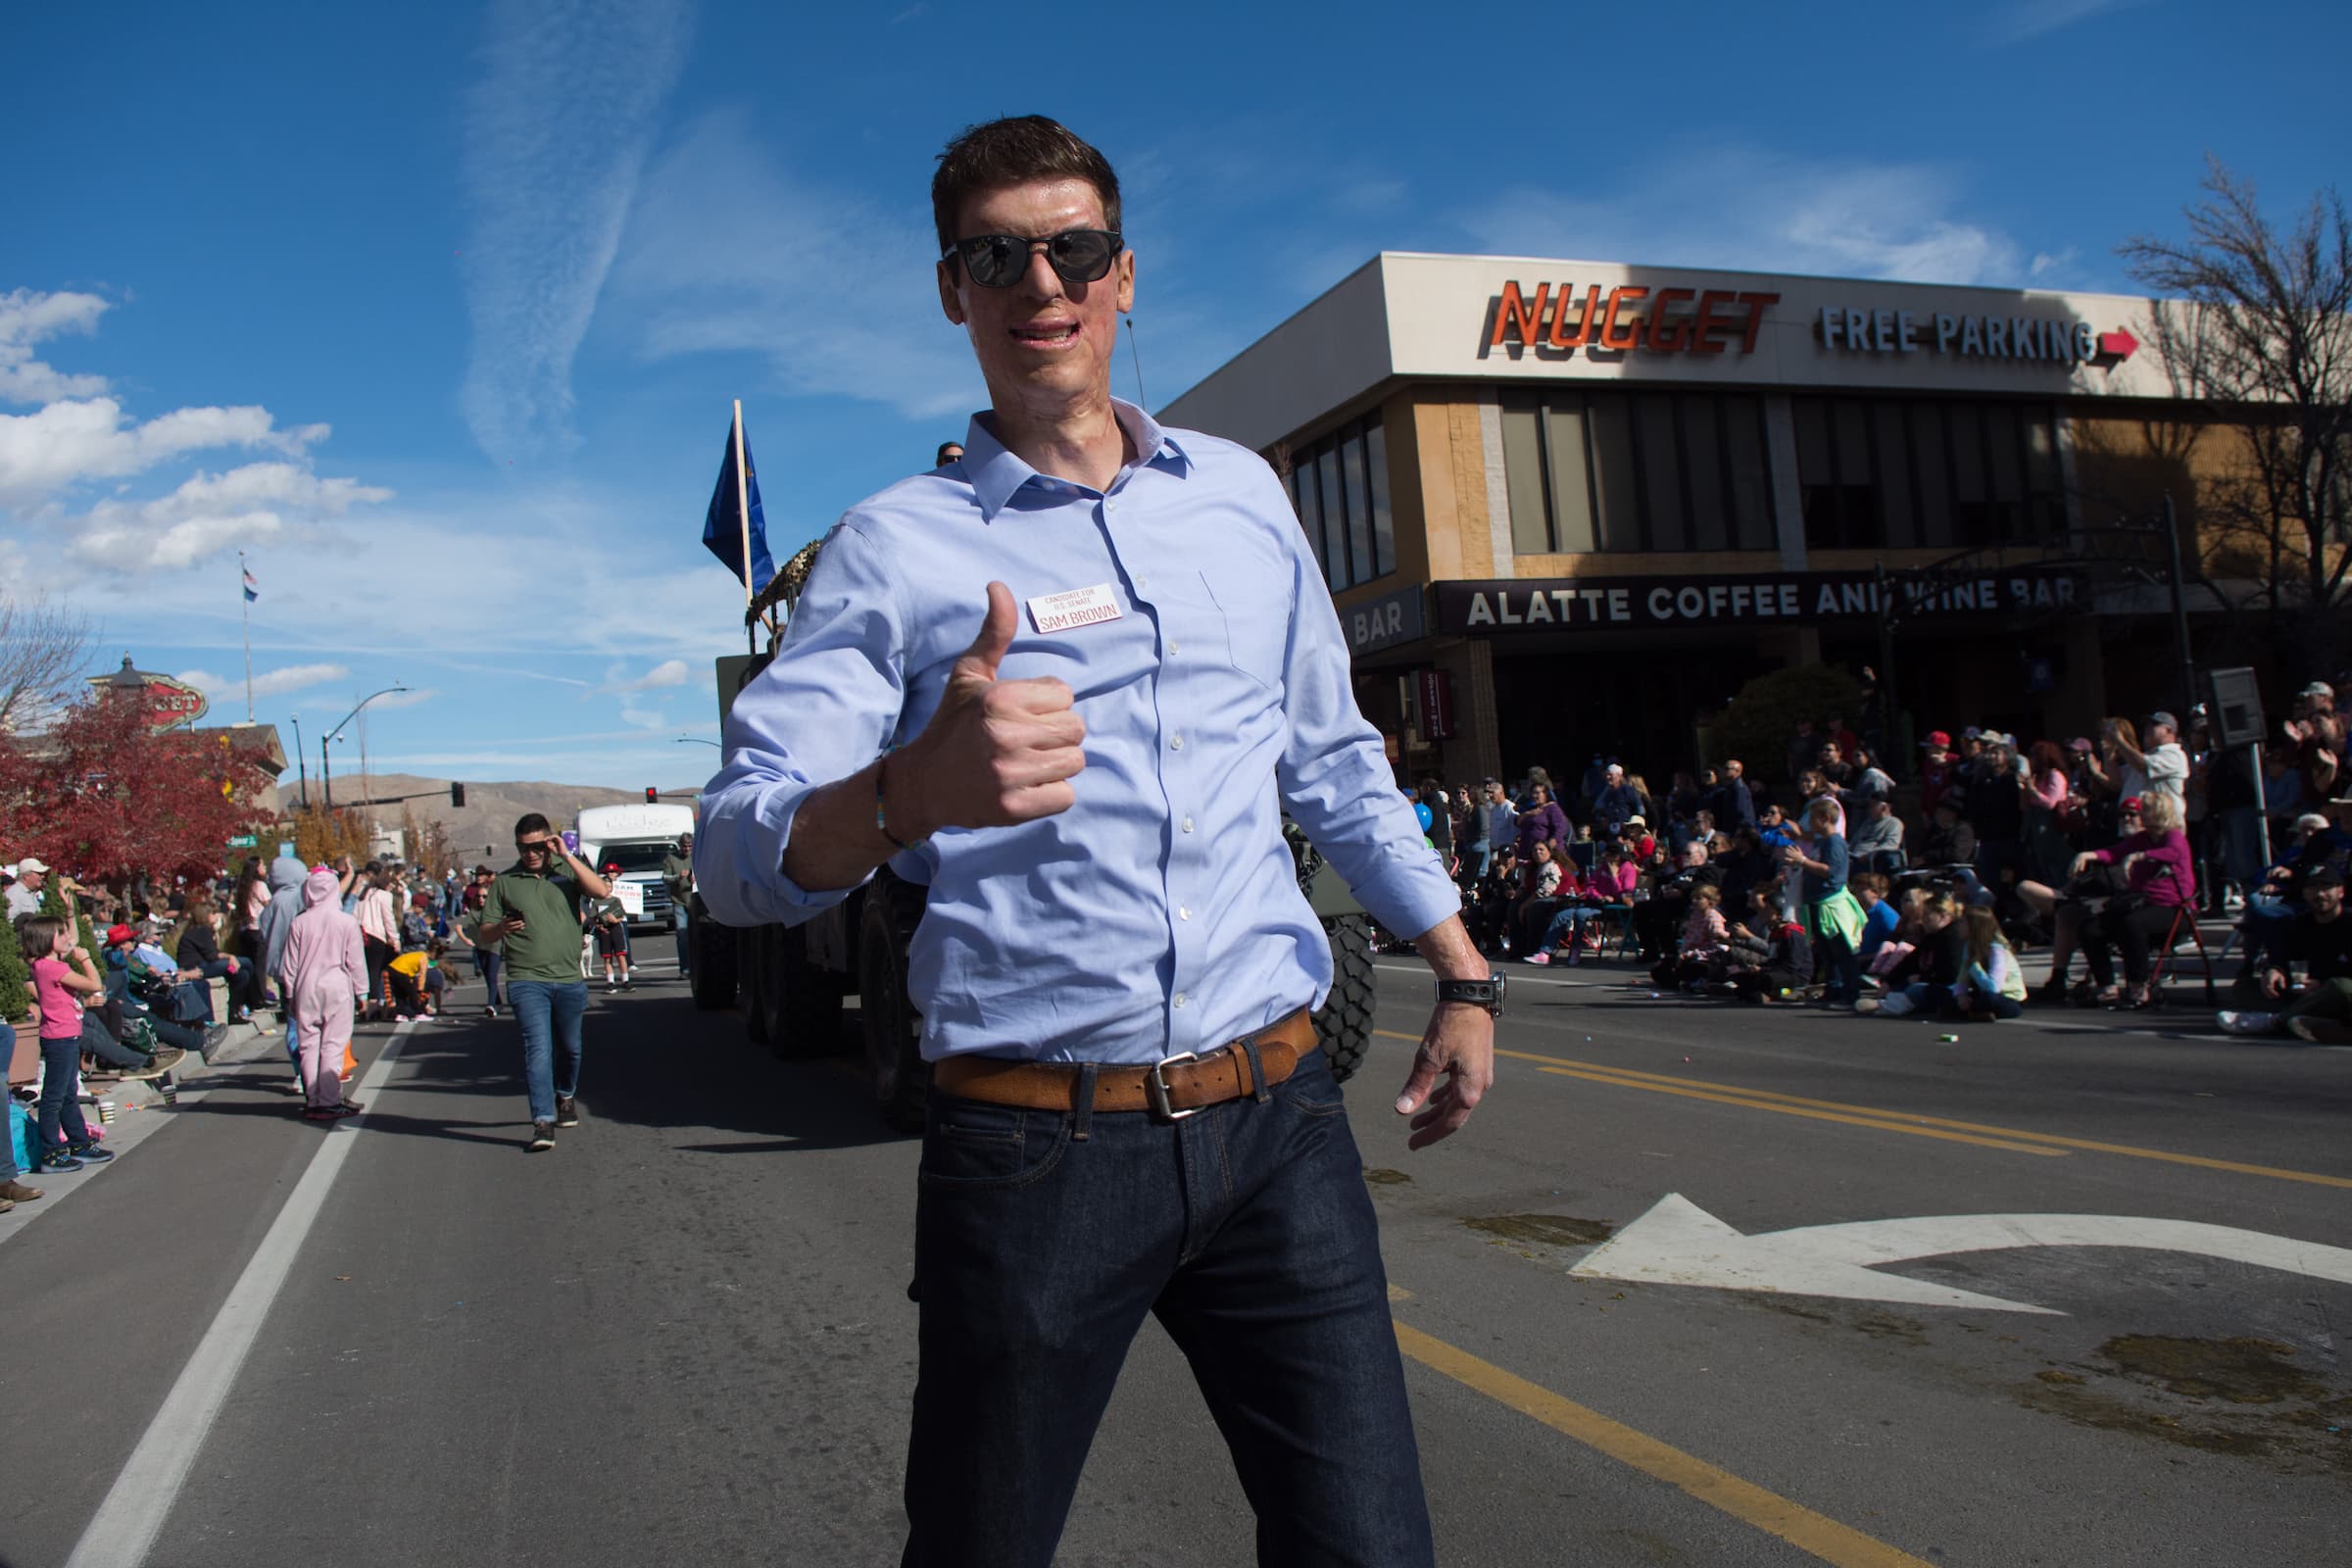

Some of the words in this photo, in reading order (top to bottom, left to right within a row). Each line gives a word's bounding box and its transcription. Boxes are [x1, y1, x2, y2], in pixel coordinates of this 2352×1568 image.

[1490, 279, 1782, 355] NUGGET
[1819, 305, 1918, 352] FREE
[1934, 312, 2097, 363] PARKING
[1040, 613, 1068, 630] SAM
[1069, 603, 1117, 624] BROWN
[1045, 591, 1080, 605] CANDIDATE
[1081, 588, 1096, 598] FOR
[1068, 597, 1091, 609] SENATE
[1466, 588, 1632, 626] ALATTE
[1647, 584, 1800, 620] COFFEE
[2010, 576, 2076, 609] BAR
[1353, 601, 1402, 645] BAR
